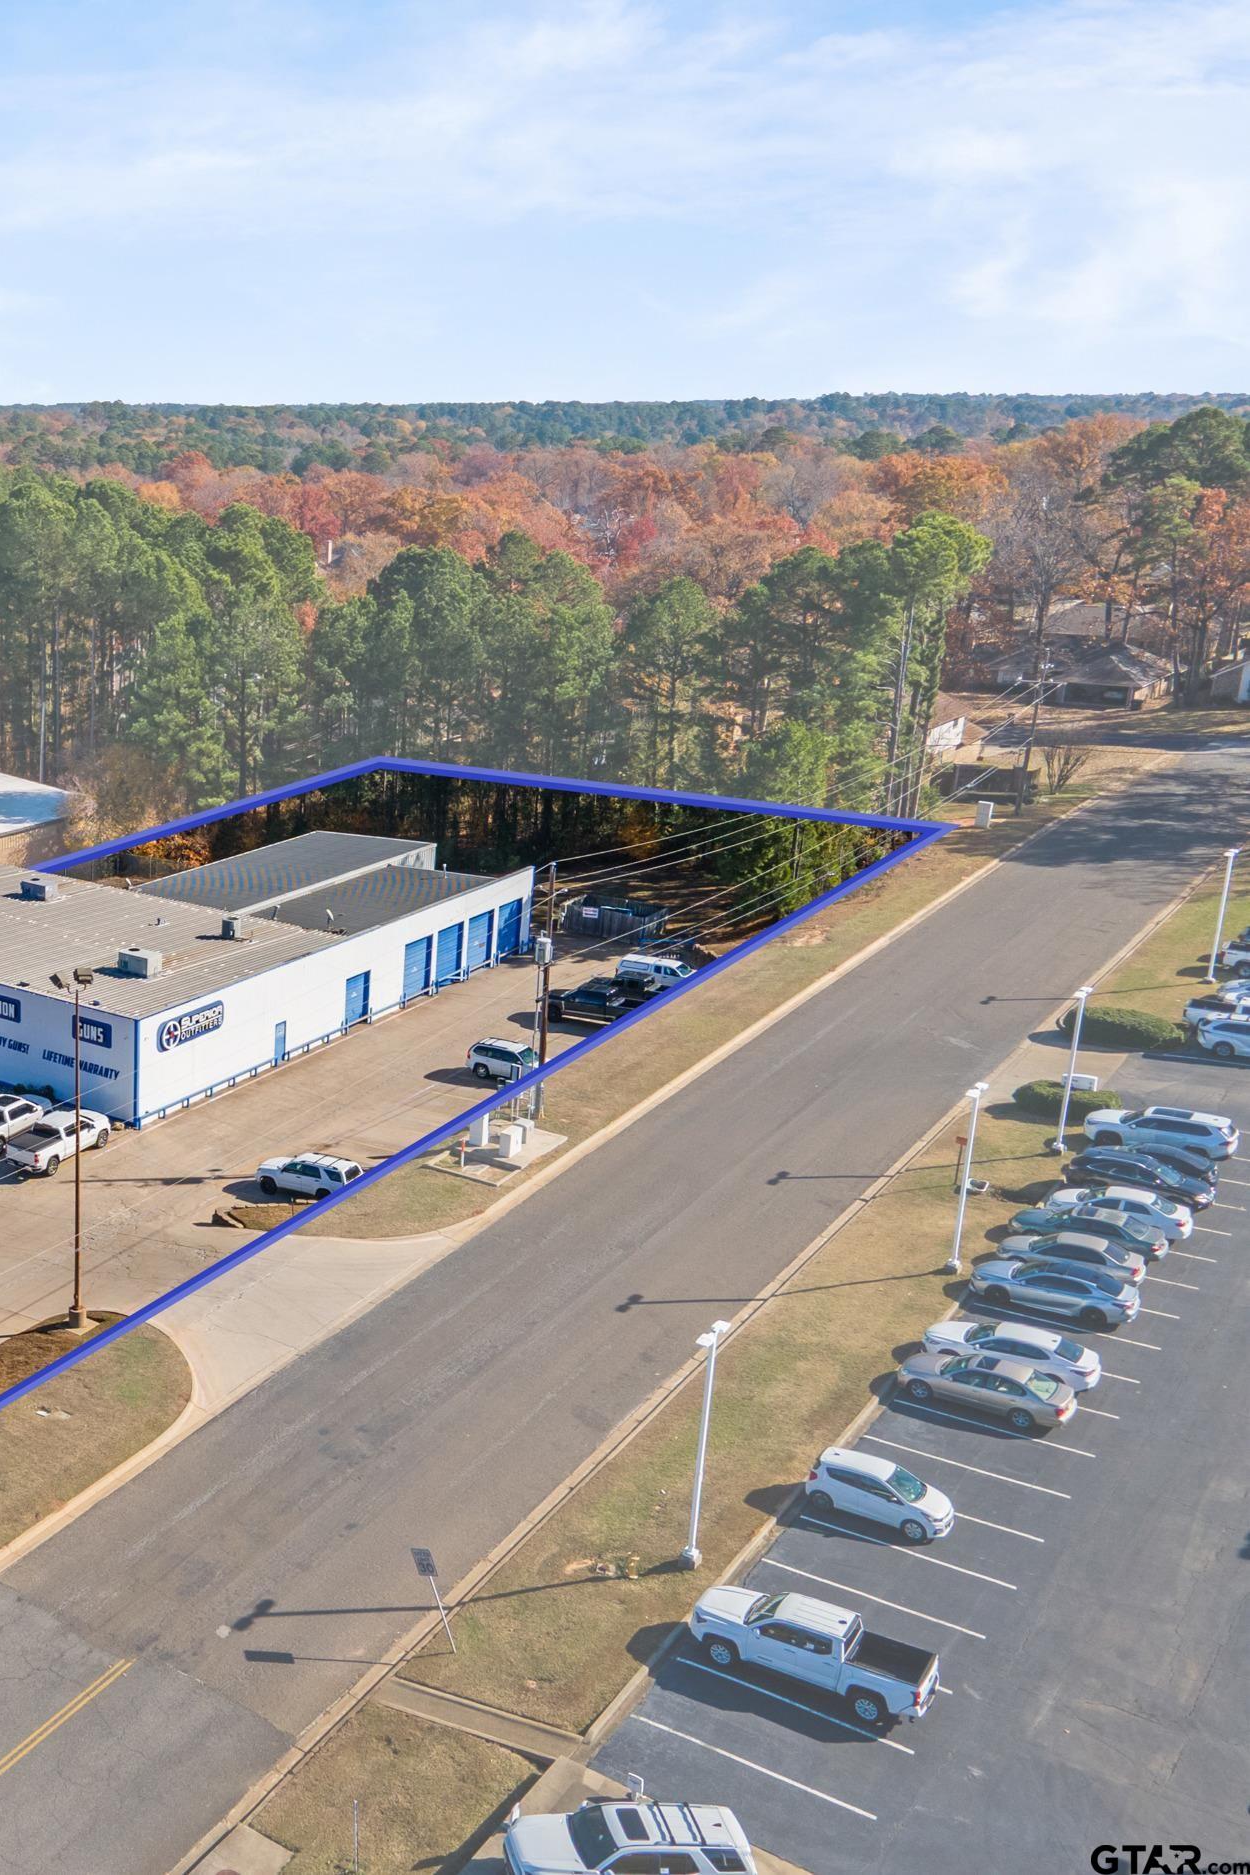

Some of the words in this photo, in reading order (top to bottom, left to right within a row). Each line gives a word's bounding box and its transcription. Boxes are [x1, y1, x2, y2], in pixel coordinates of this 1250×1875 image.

[181, 1004, 223, 1029] SUPERIOR
[78, 1022, 104, 1043] GUNS
[181, 1016, 223, 1040] OUTFITTERS
[7, 1038, 31, 1055] GUNS!
[42, 1049, 76, 1068] LIFETIME
[418, 1562, 435, 1573] 30
